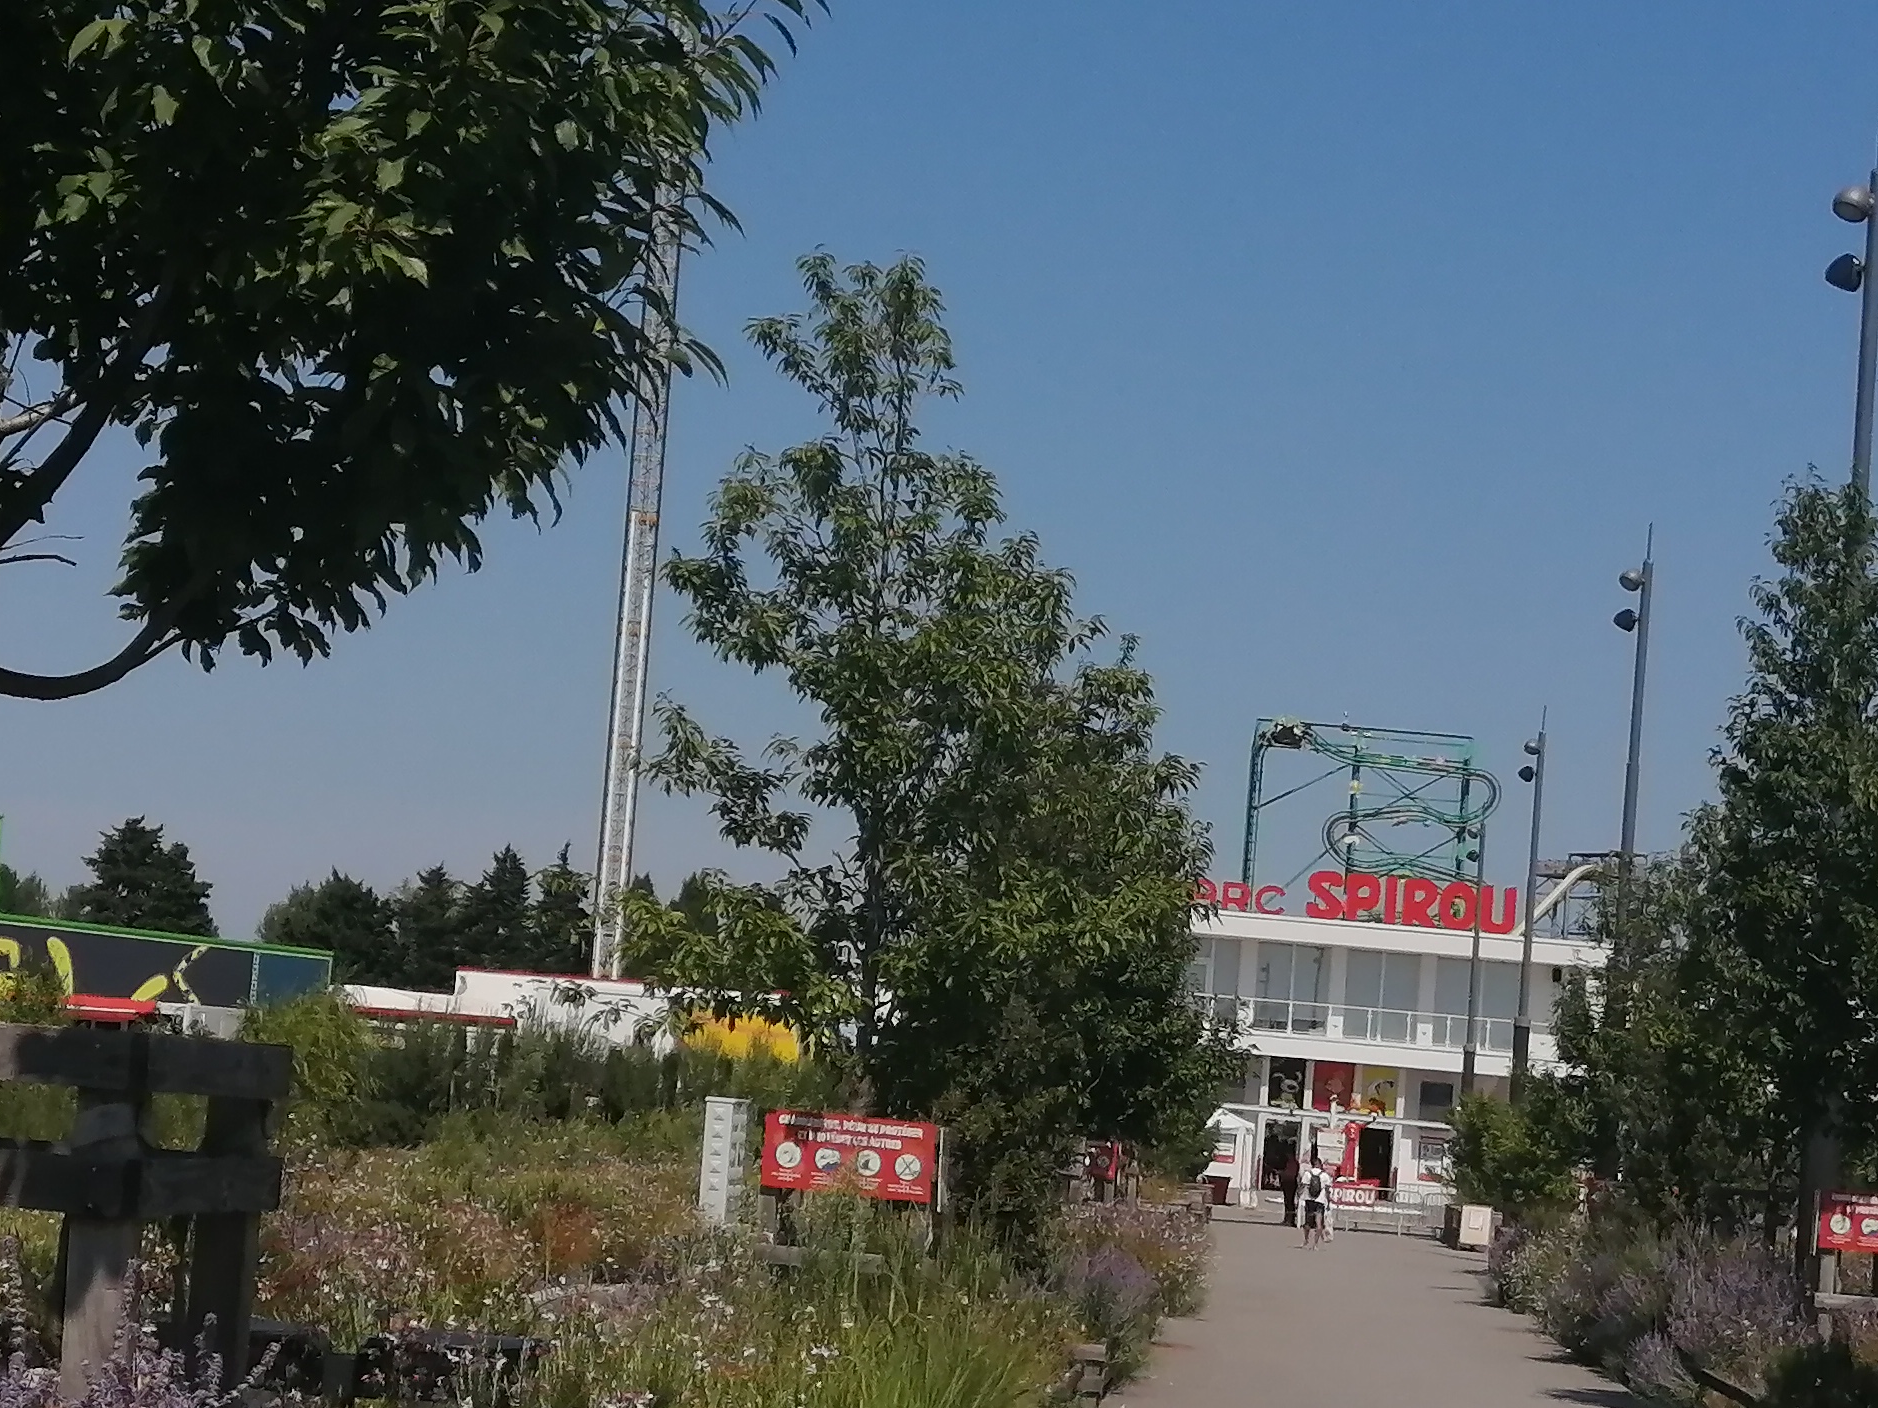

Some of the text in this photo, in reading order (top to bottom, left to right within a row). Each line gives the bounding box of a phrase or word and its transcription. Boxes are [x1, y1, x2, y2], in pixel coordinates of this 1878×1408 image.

[1189, 870, 1518, 934] ARC SPIROU
[1329, 1188, 1376, 1205] PIROU
